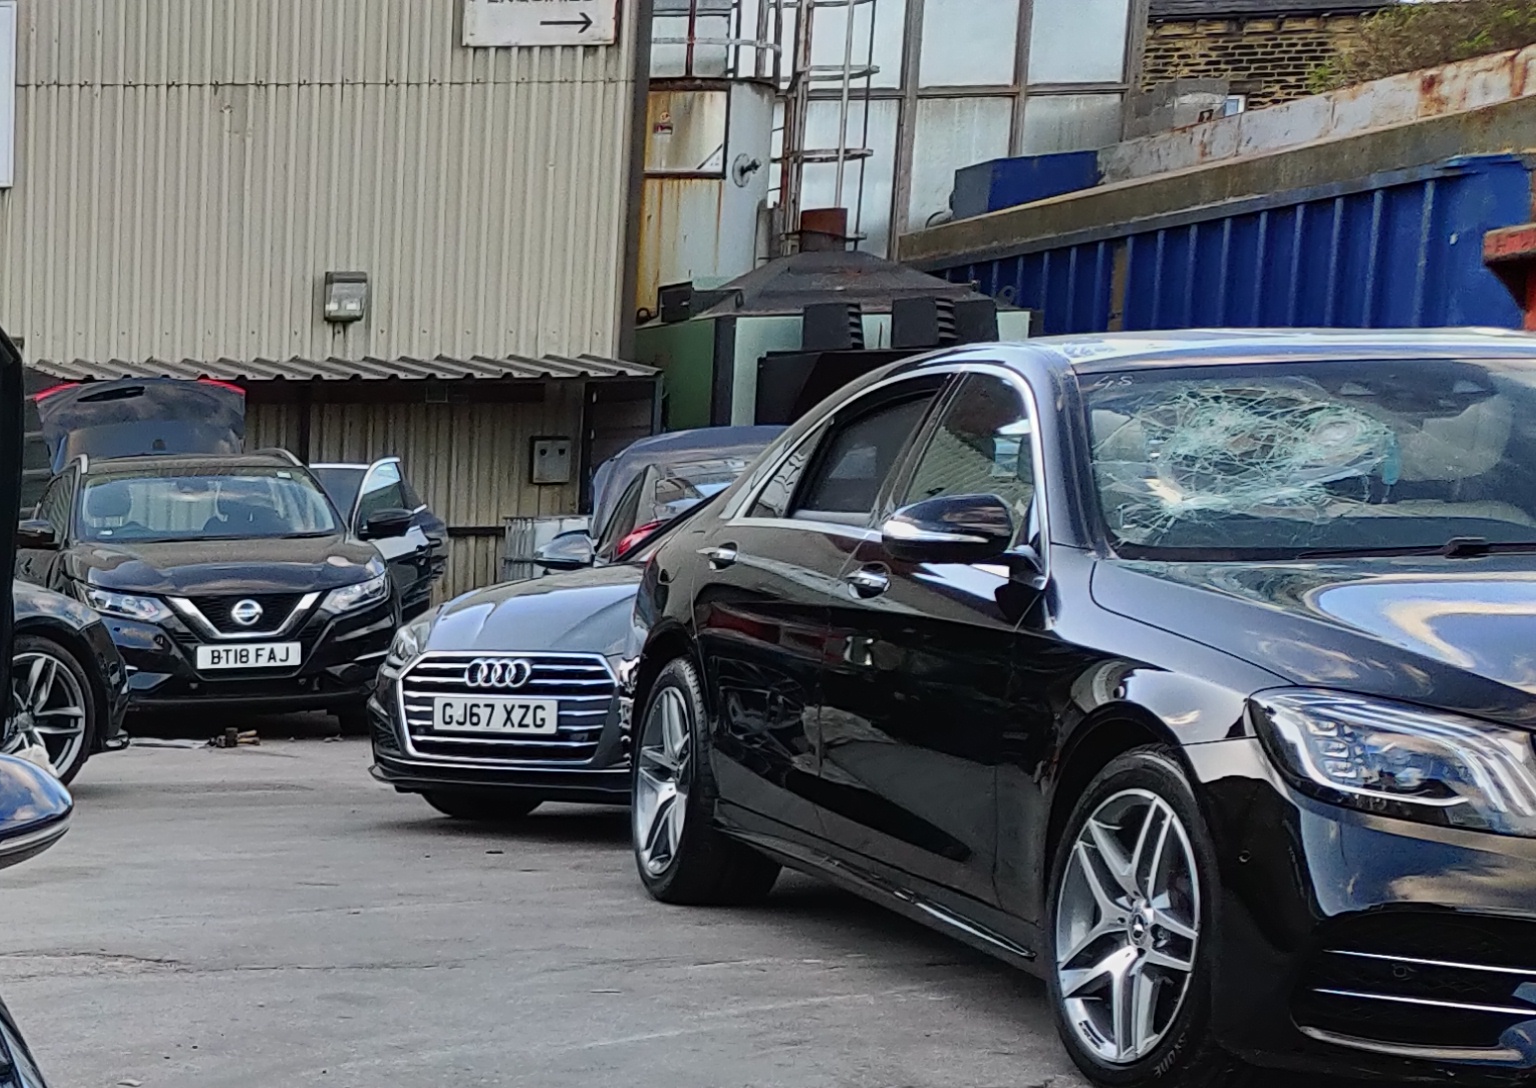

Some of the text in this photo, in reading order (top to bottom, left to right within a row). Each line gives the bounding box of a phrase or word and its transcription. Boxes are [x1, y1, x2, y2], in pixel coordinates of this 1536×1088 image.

[210, 646, 290, 666] BT18 FAJ
[442, 702, 547, 729] GJ67 XZG
